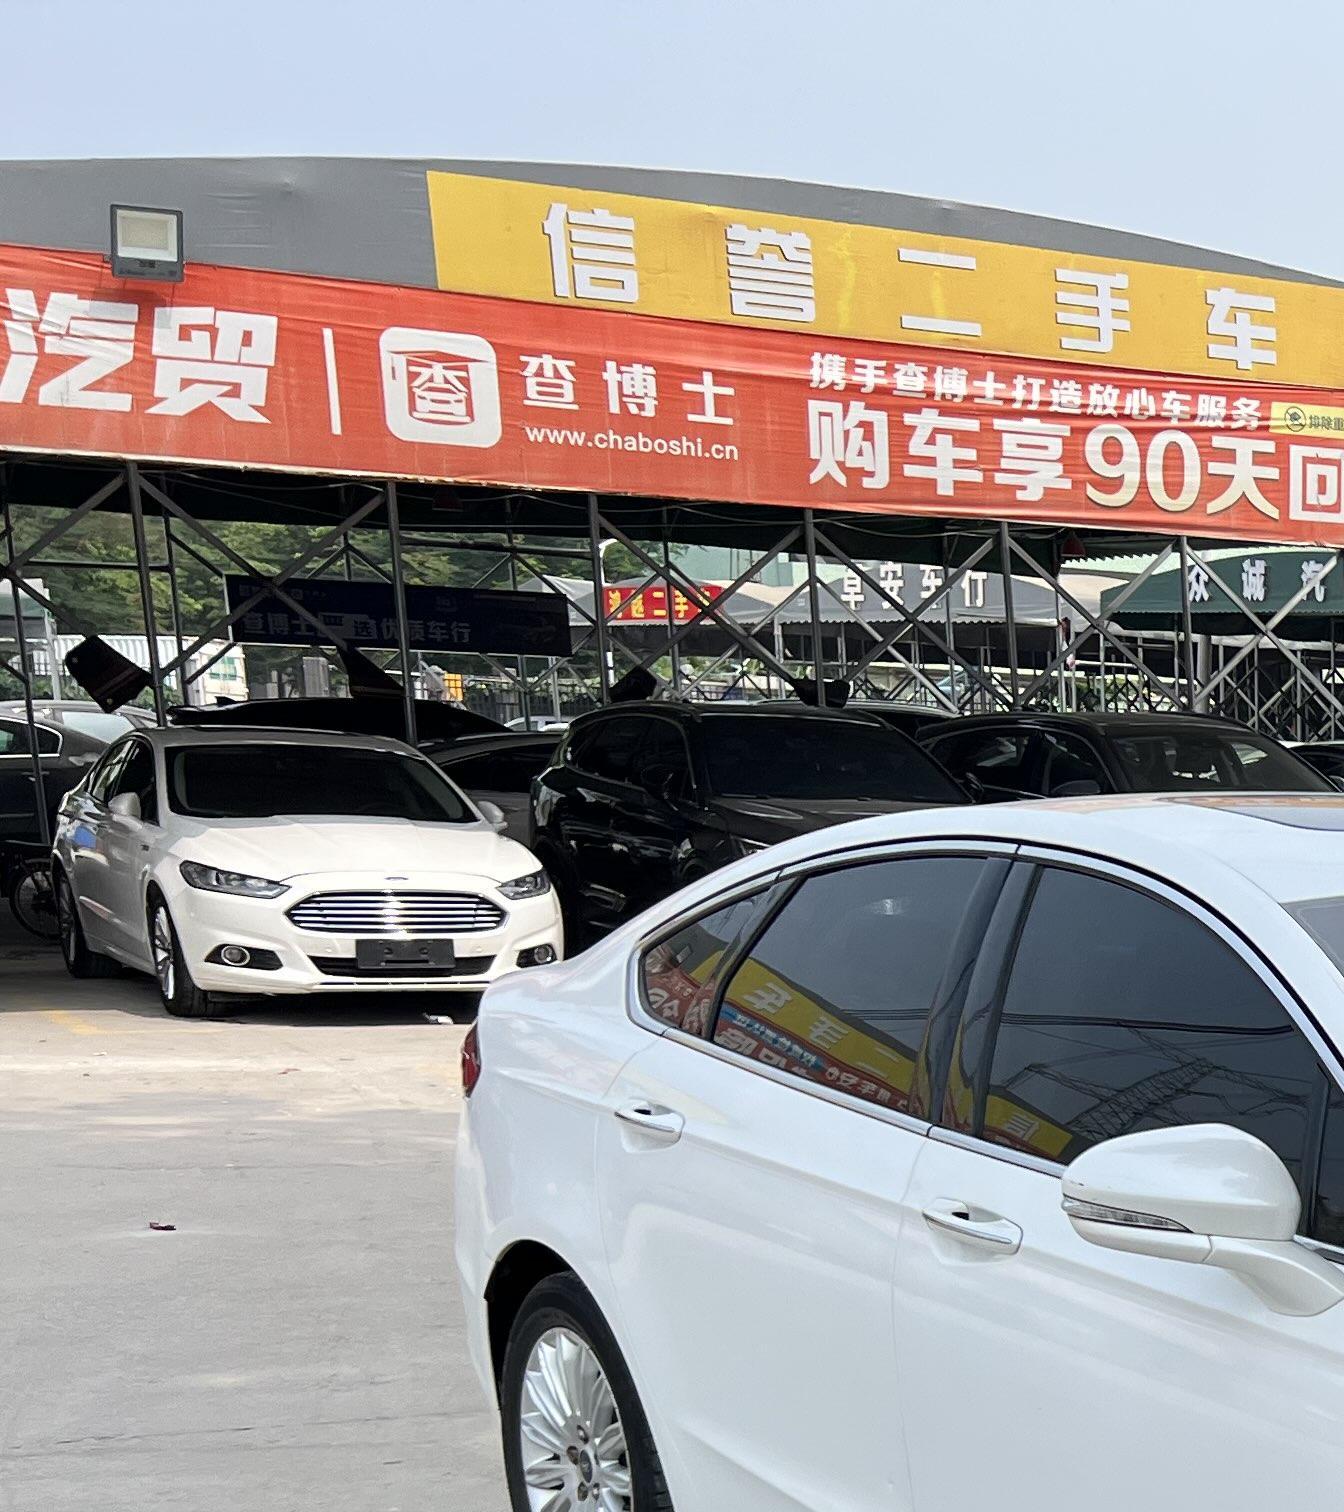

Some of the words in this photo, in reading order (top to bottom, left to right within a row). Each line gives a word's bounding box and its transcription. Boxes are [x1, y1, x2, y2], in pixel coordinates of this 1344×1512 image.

[543, 203, 1277, 370] 信誉二手车
[0, 287, 279, 424] 汽贸
[519, 354, 736, 425] 查博士
[809, 352, 1262, 432] 携手查博士打造放心车服务
[524, 425, 739, 460] www.chaboshi.cn
